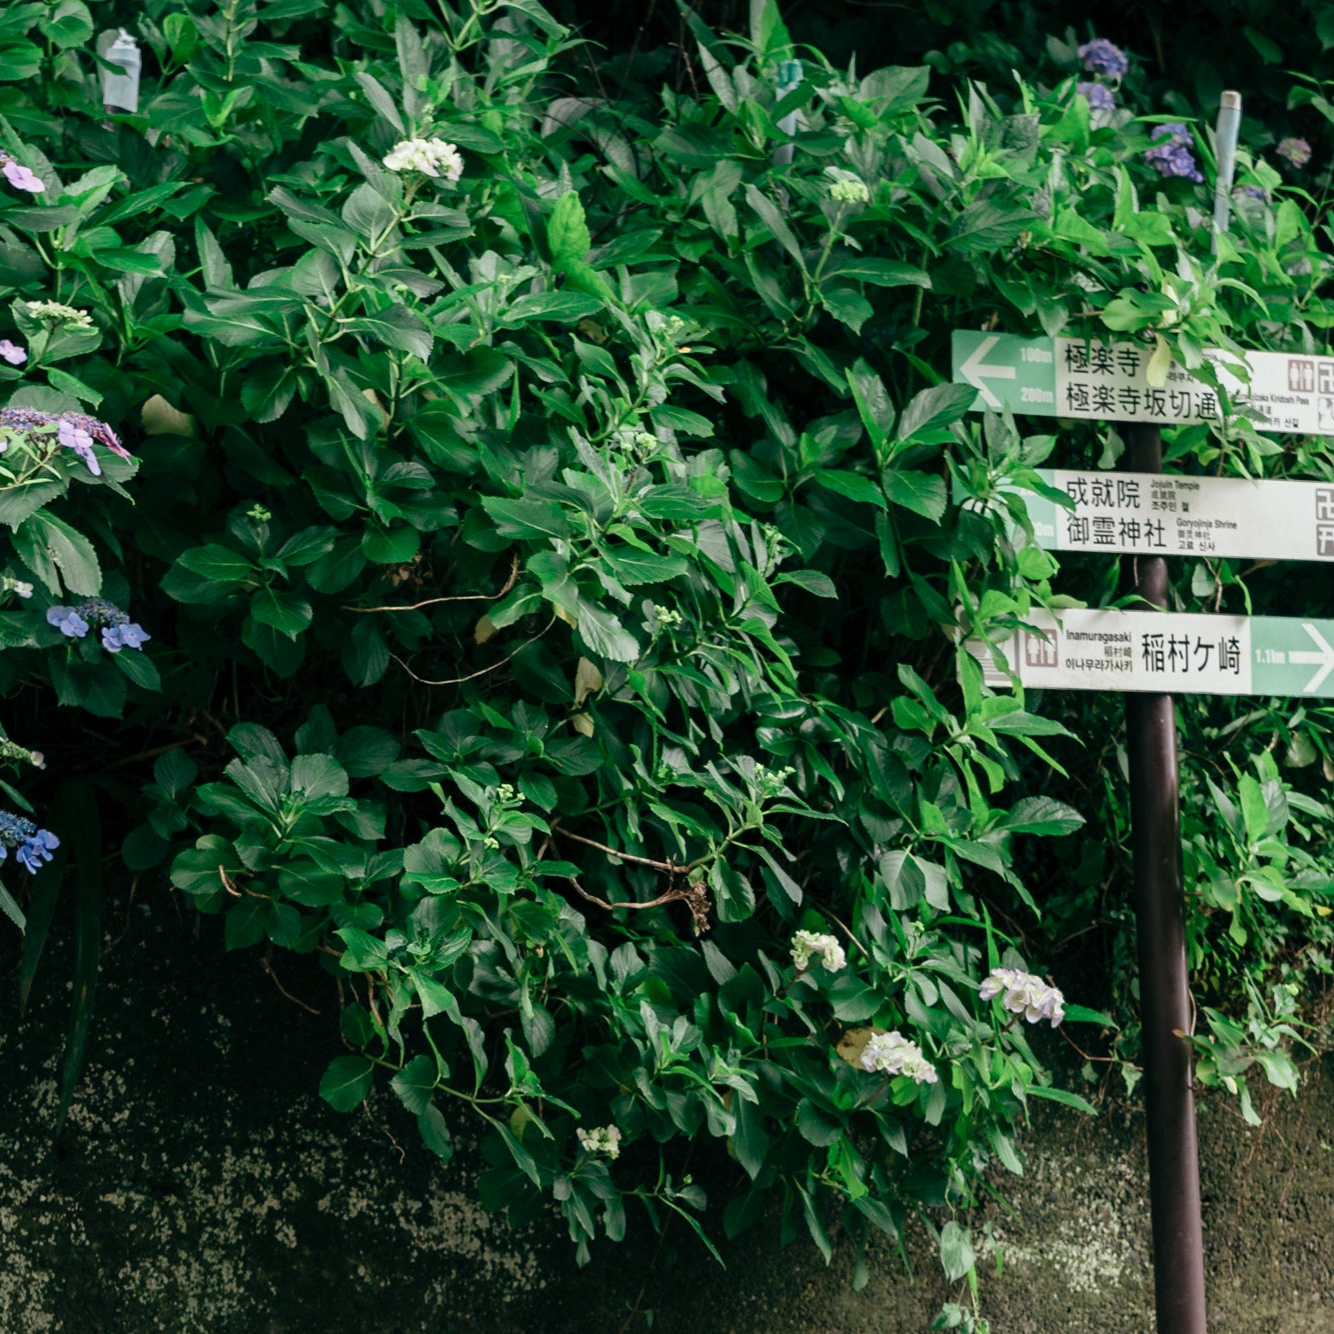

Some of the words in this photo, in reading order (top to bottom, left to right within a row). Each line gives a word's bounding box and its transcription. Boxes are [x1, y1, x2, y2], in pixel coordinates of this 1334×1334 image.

[1020, 347, 1053, 364] 100m
[1065, 343, 1141, 378] 極楽寺
[1020, 386, 1054, 404] 200m
[1065, 382, 1217, 421] 極楽寺坂切通
[1067, 476, 1141, 509] 成就院
[1174, 480, 1200, 491] Temple
[1067, 516, 1167, 549] 御霊神社
[1214, 519, 1237, 530] Shrine
[1066, 629, 1132, 645] Inamuragasaki
[1065, 658, 1134, 673] 이나무라가사키
